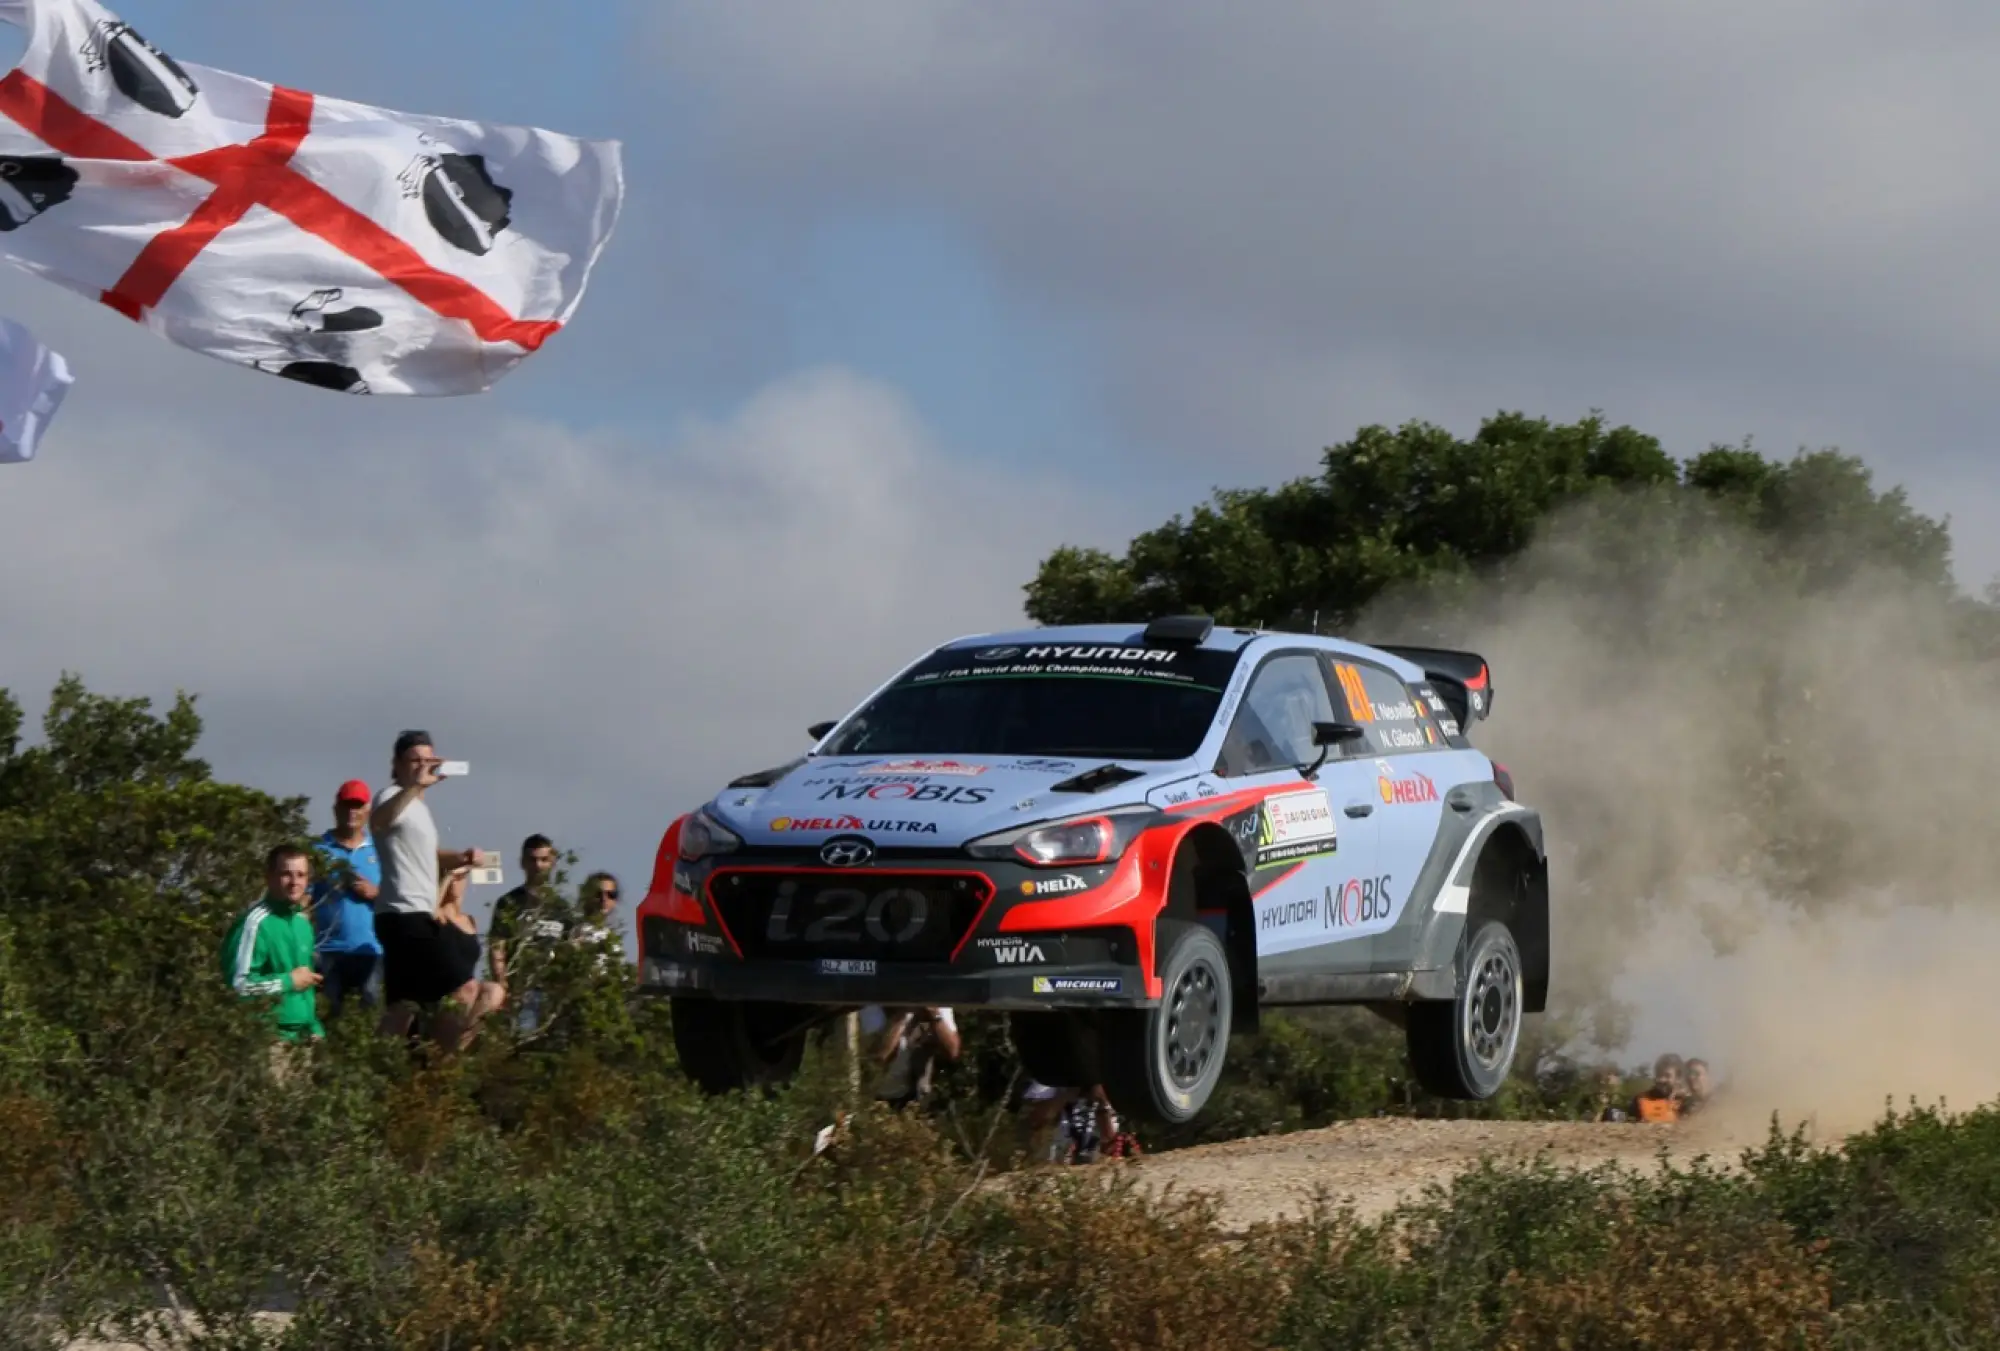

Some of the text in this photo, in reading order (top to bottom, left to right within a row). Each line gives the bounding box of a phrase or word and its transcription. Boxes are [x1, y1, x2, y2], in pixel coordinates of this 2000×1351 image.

[1025, 646, 1178, 663] HYUNDAI
[973, 666, 1009, 675] World
[1011, 664, 1043, 674] Rally
[1046, 664, 1135, 676] Championship
[817, 783, 994, 804] MOBIS
[1391, 770, 1440, 803] HELIX
[791, 814, 937, 834] HELIX ULTRA
[1036, 874, 1088, 894] HELIX
[766, 880, 928, 943] i20
[1262, 874, 1392, 930] HYUNDAI MOBIS
[1055, 979, 1117, 990] MICHELIN
